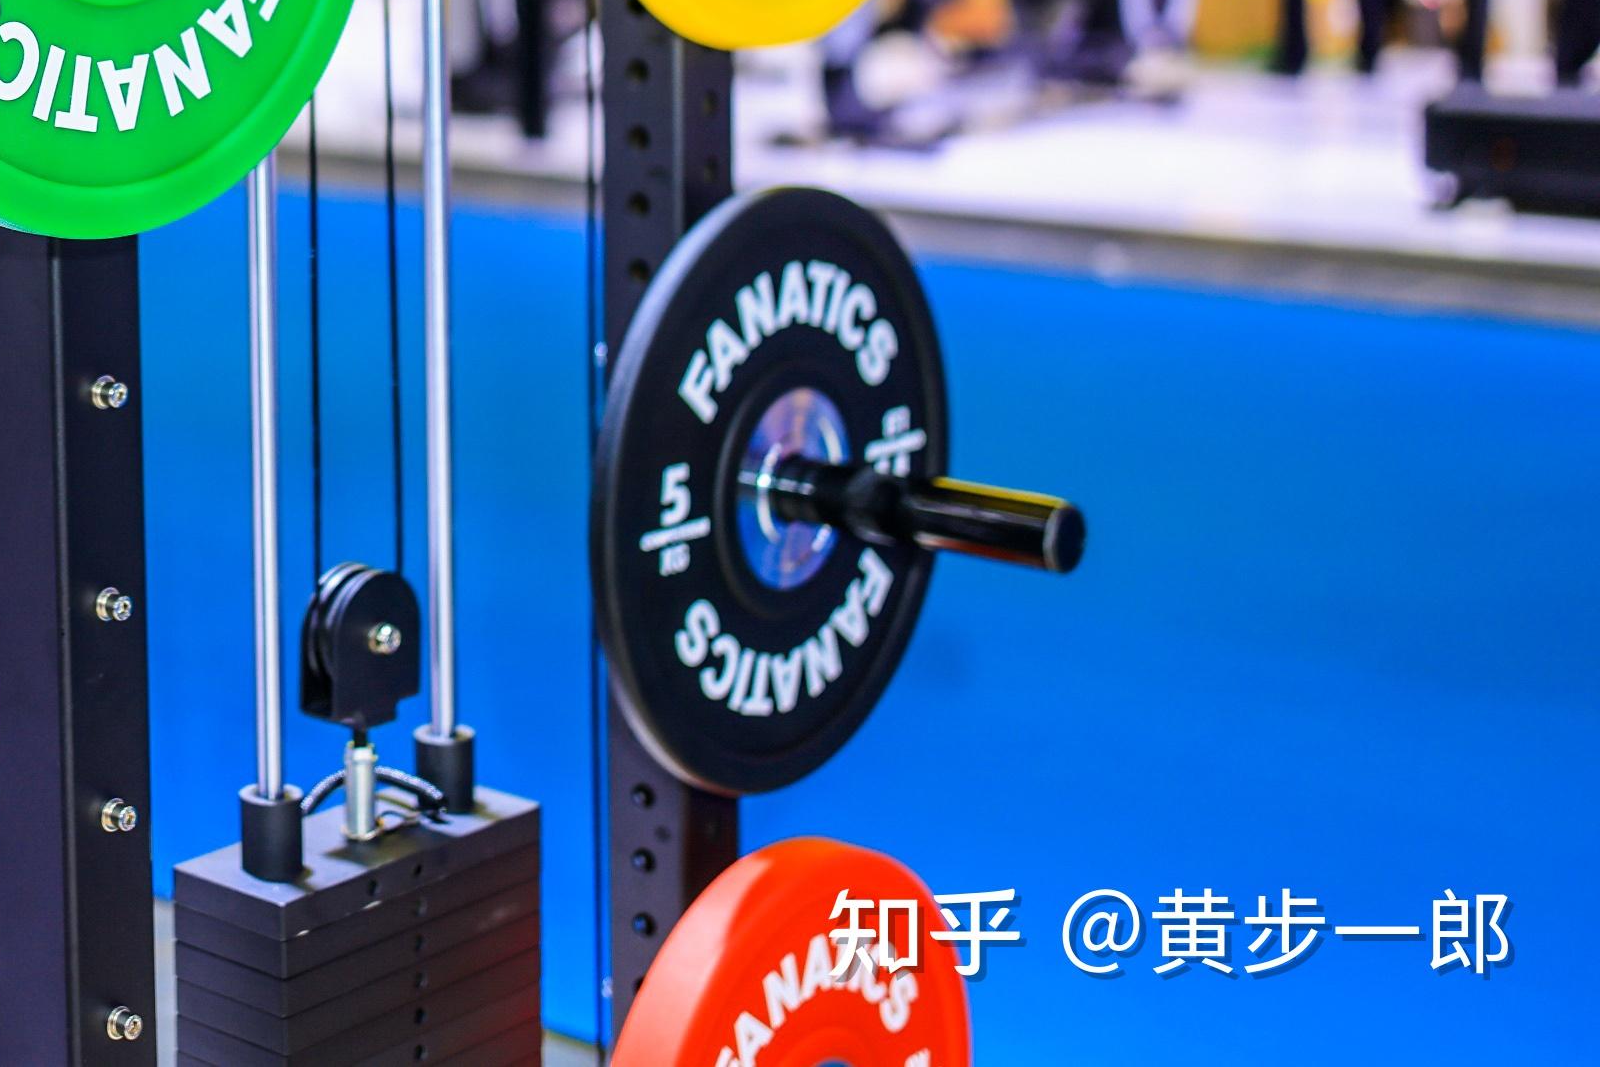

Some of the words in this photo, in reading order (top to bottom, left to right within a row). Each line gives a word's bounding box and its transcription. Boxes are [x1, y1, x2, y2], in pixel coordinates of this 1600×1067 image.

[677, 259, 899, 425] FANATICS
[660, 462, 691, 528] 5
[674, 598, 894, 717] FANATICS
